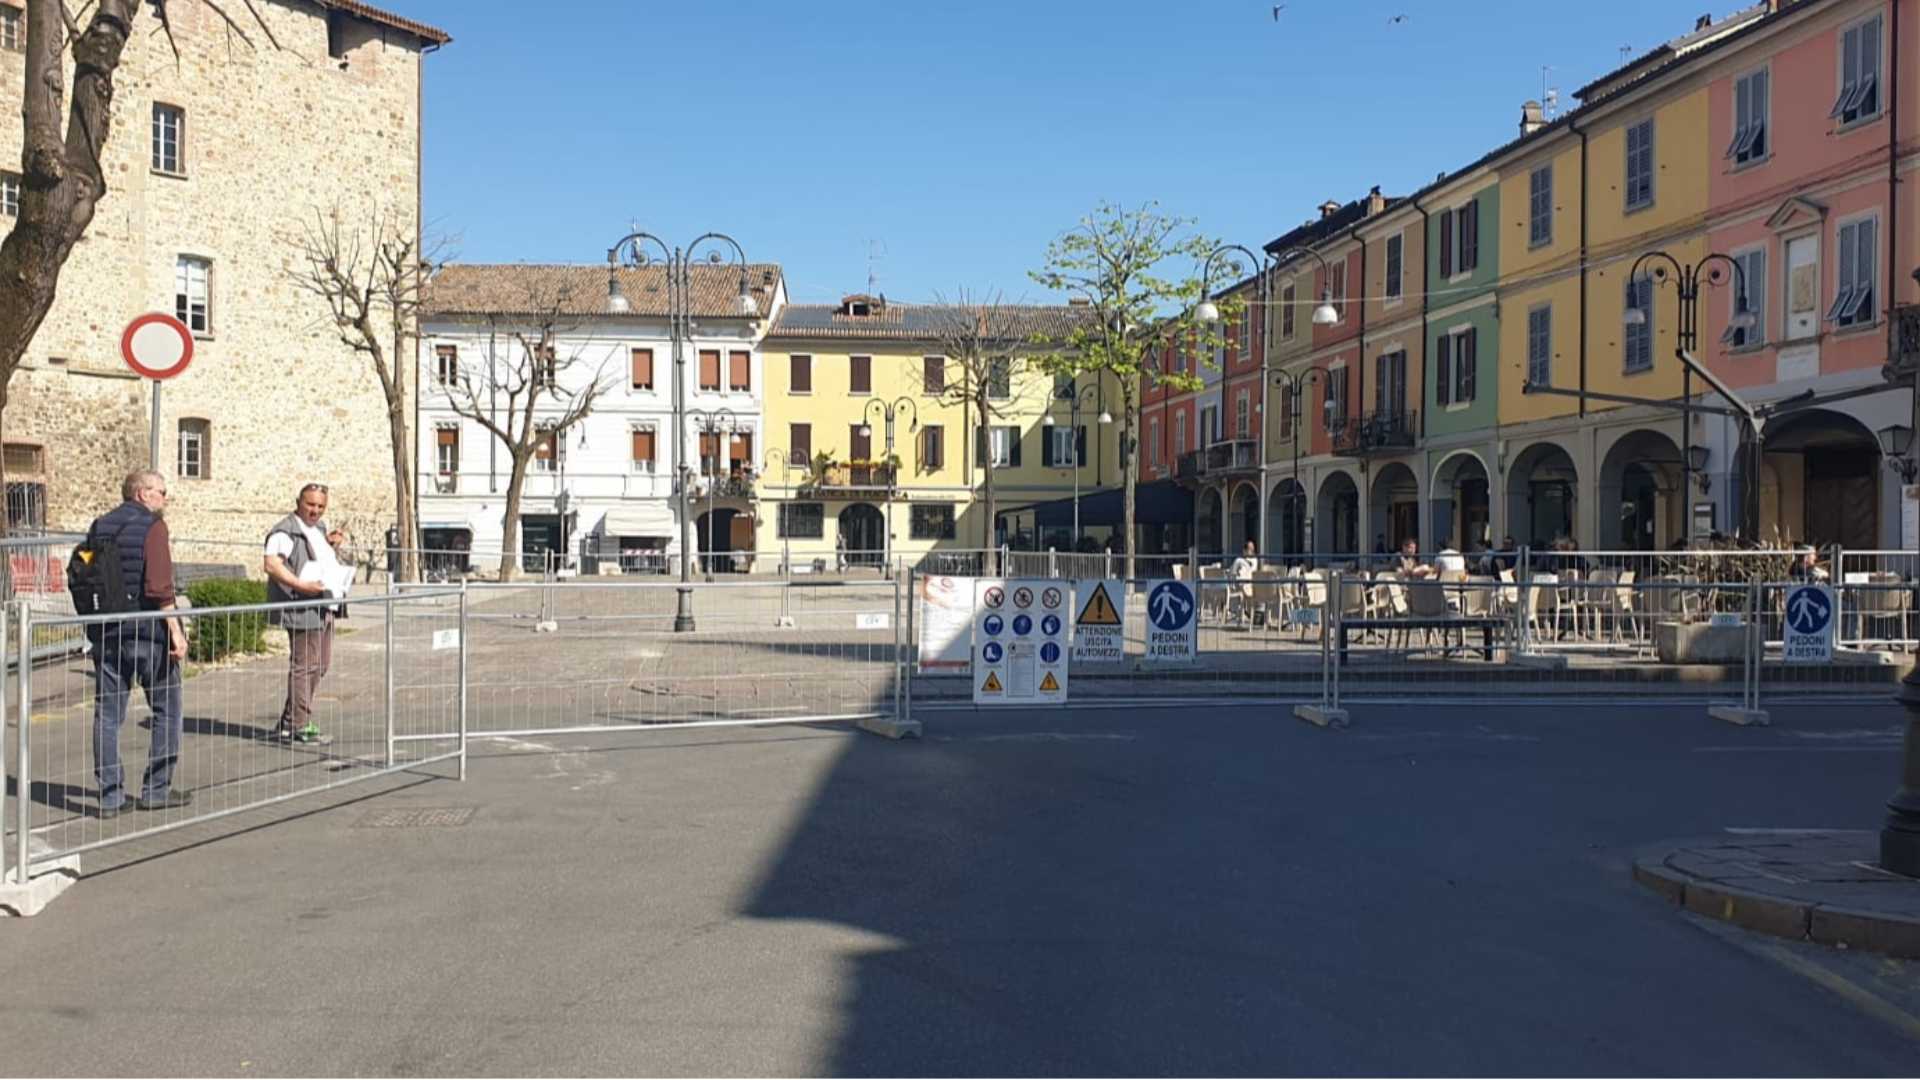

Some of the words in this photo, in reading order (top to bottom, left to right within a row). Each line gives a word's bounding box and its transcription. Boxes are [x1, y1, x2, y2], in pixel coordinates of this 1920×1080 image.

[1076, 627, 1122, 636] ATTENZIONE
[1085, 637, 1112, 646] USCITA
[1152, 632, 1188, 642] PEDONI
[1790, 635, 1825, 646] PEDONI
[1075, 647, 1120, 657] AUTOMEZZI
[1158, 645, 1189, 657] DESTRA
[1795, 647, 1826, 658] DESTRA
